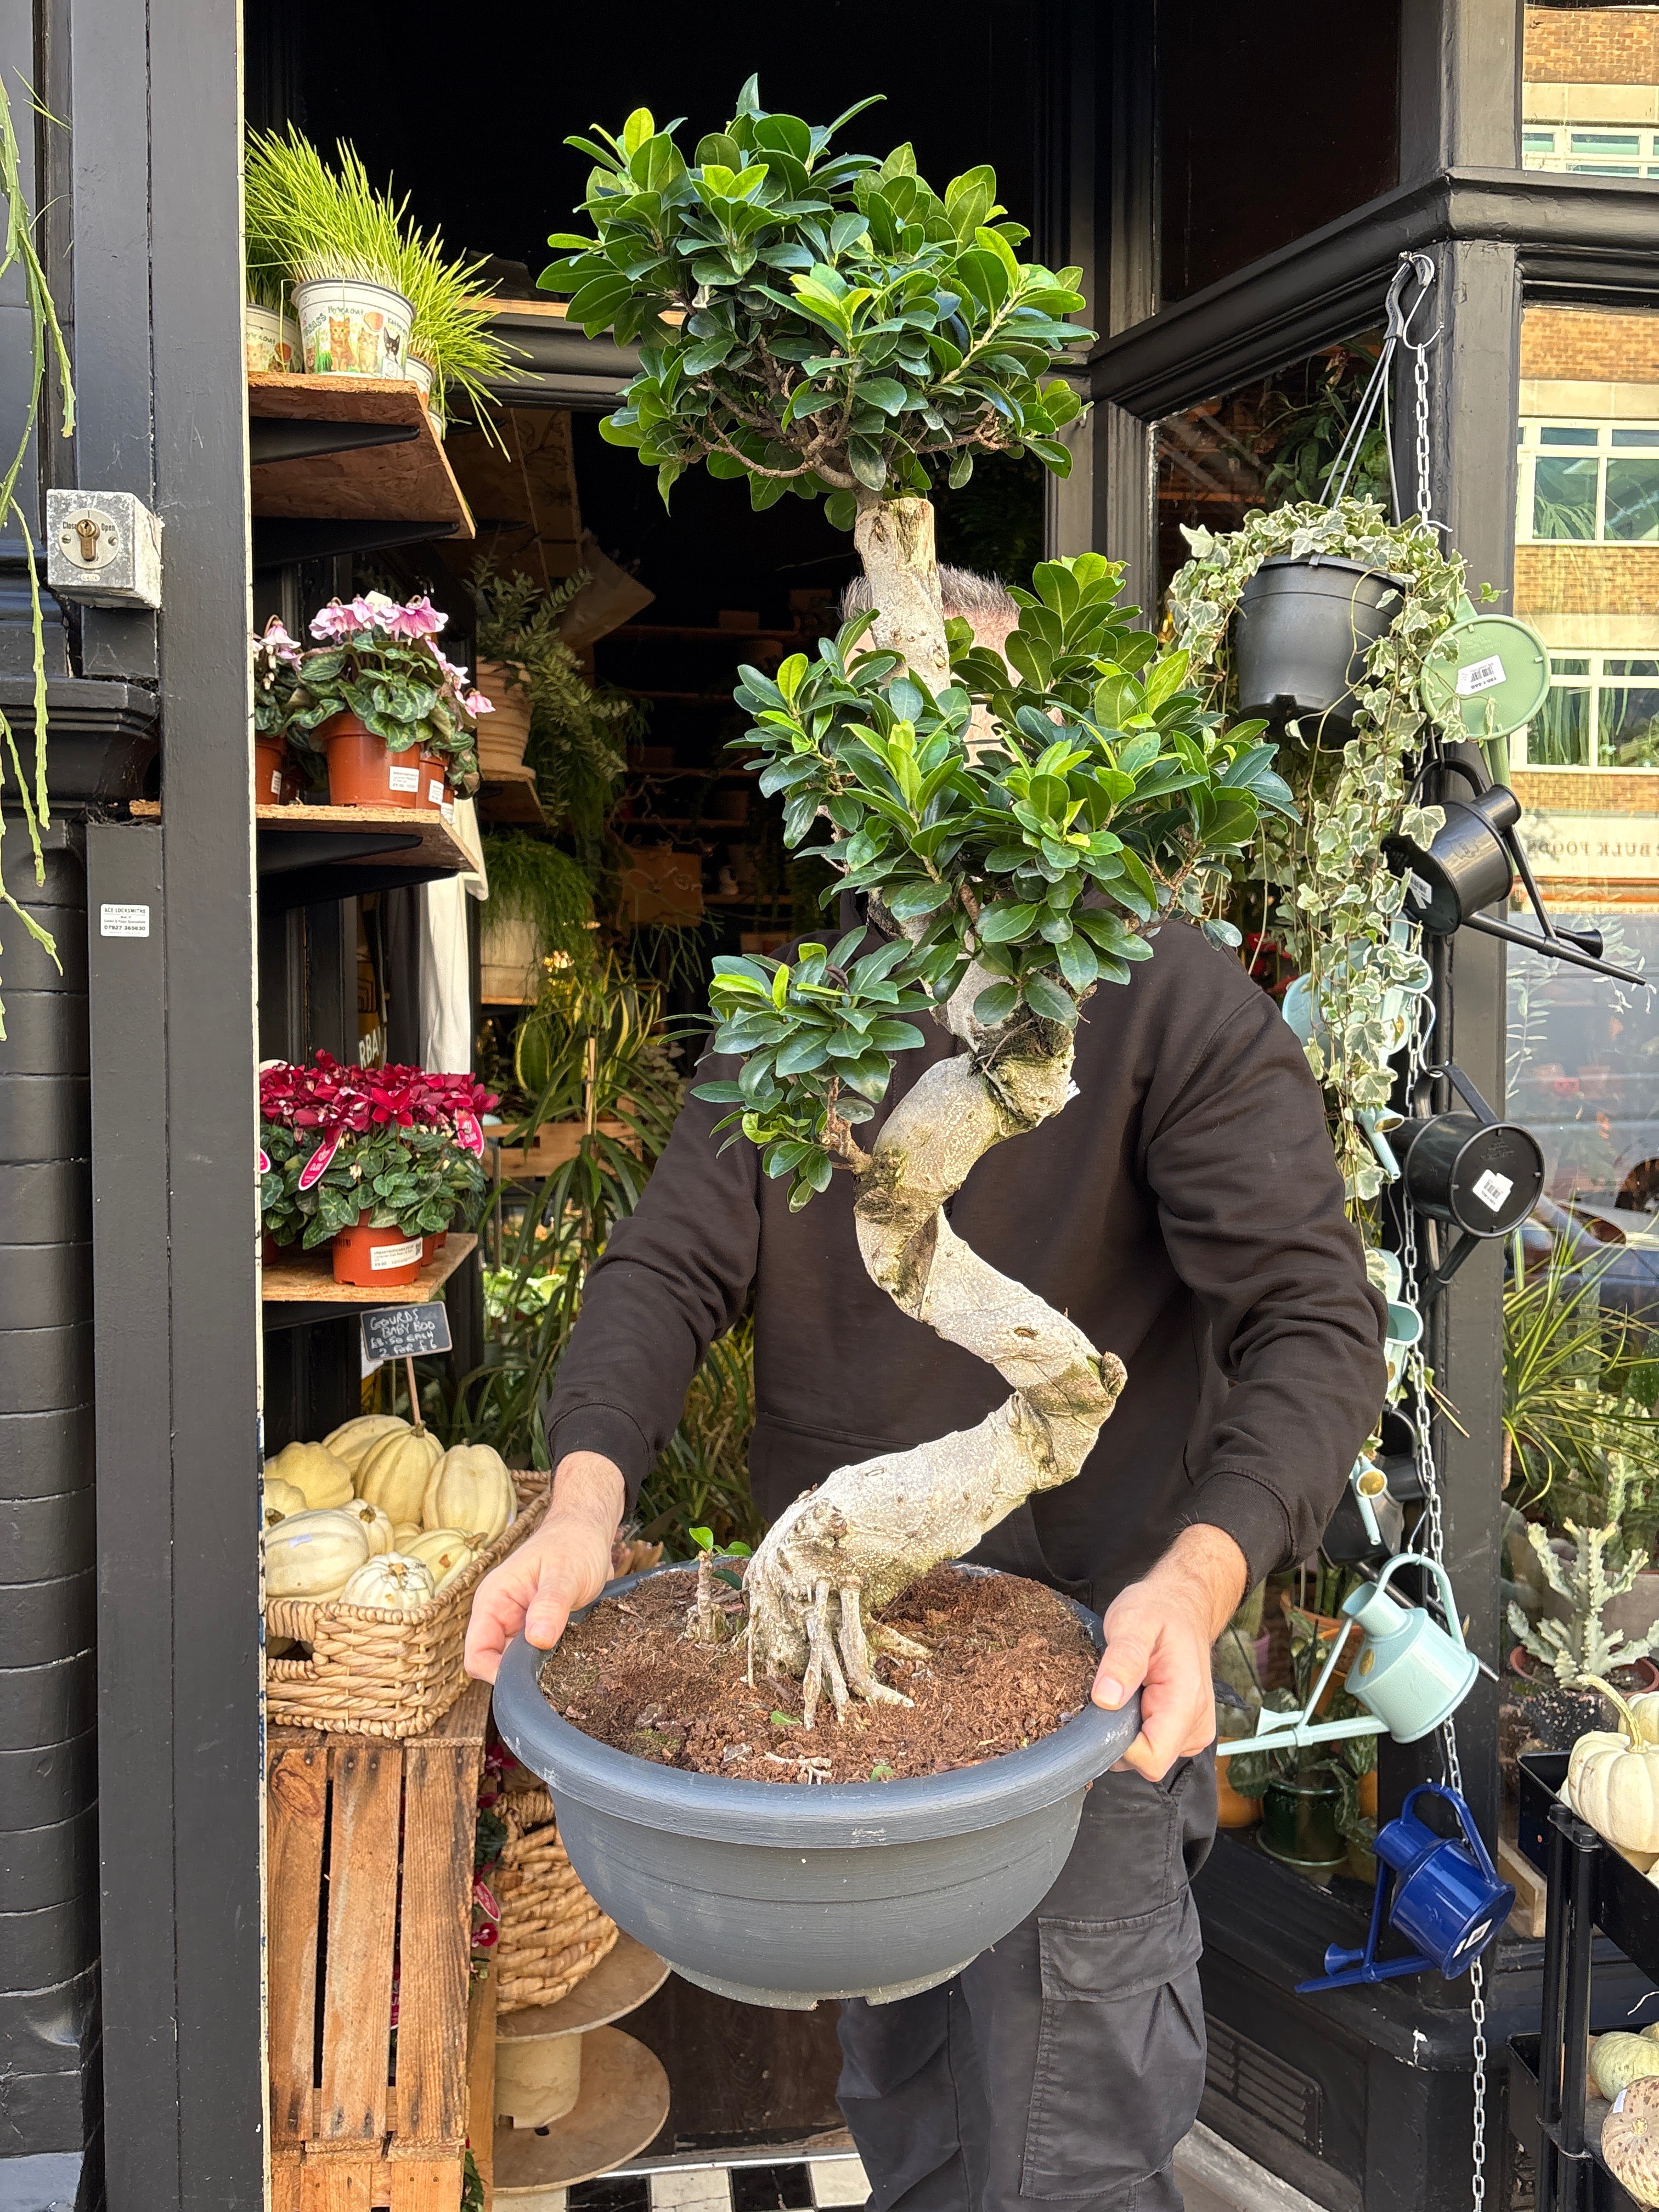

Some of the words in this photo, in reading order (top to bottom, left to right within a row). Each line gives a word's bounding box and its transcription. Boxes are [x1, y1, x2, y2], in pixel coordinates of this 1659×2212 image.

[101, 523, 115, 533] Open
[370, 1308, 418, 1331] GOURDS
[381, 1323, 410, 1339] BABY
[413, 1321, 436, 1332] BOO
[407, 1330, 434, 1342] EACH
[379, 1347, 390, 1358] 2
[393, 1342, 414, 1355] FOR
